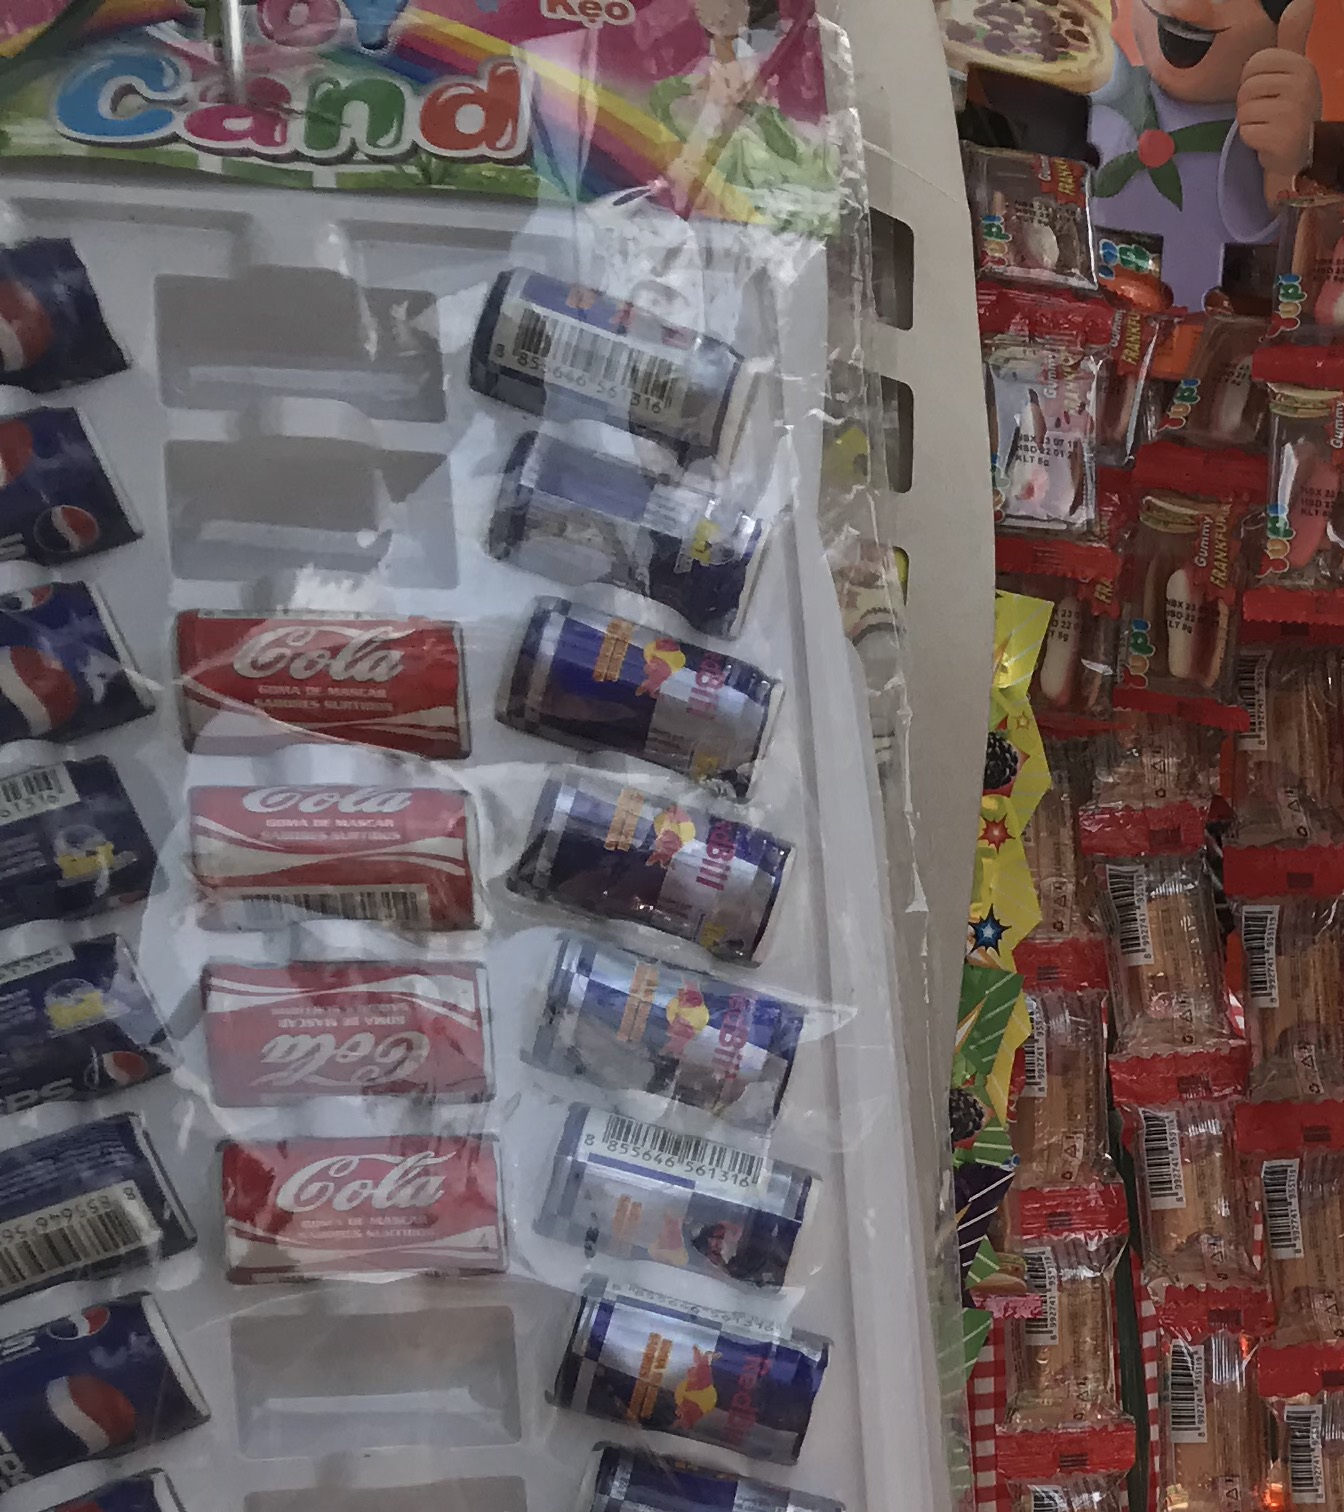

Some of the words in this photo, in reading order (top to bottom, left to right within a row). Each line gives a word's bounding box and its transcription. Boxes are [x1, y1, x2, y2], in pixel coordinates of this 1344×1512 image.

[1259, 274, 1307, 341] Yupi
[1155, 378, 1200, 434] Yupi
[1194, 516, 1212, 567] Gummy
[1256, 503, 1297, 578] Yupi
[233, 626, 416, 682] Cola
[1120, 619, 1155, 689] Yupi
[242, 786, 415, 813] Cola
[1140, 913, 1150, 946] 992741
[1267, 917, 1276, 947] 955119
[1267, 957, 1276, 990] 992741
[251, 1031, 430, 1086] Cola
[584, 1133, 595, 1146] 8
[607, 1141, 675, 1169] 855646
[684, 1163, 750, 1188] 561316
[1172, 1158, 1181, 1190] 992741
[276, 1151, 456, 1212] Cola
[1288, 1169, 1296, 1199] 955119
[1291, 1209, 1299, 1241] 992741
[1042, 1256, 1055, 1286] 955119
[1047, 1296, 1056, 1328] 992741
[1194, 1357, 1202, 1384] 955119
[1195, 1394, 1204, 1425] 992741
[1313, 1455, 1321, 1486] 992741
